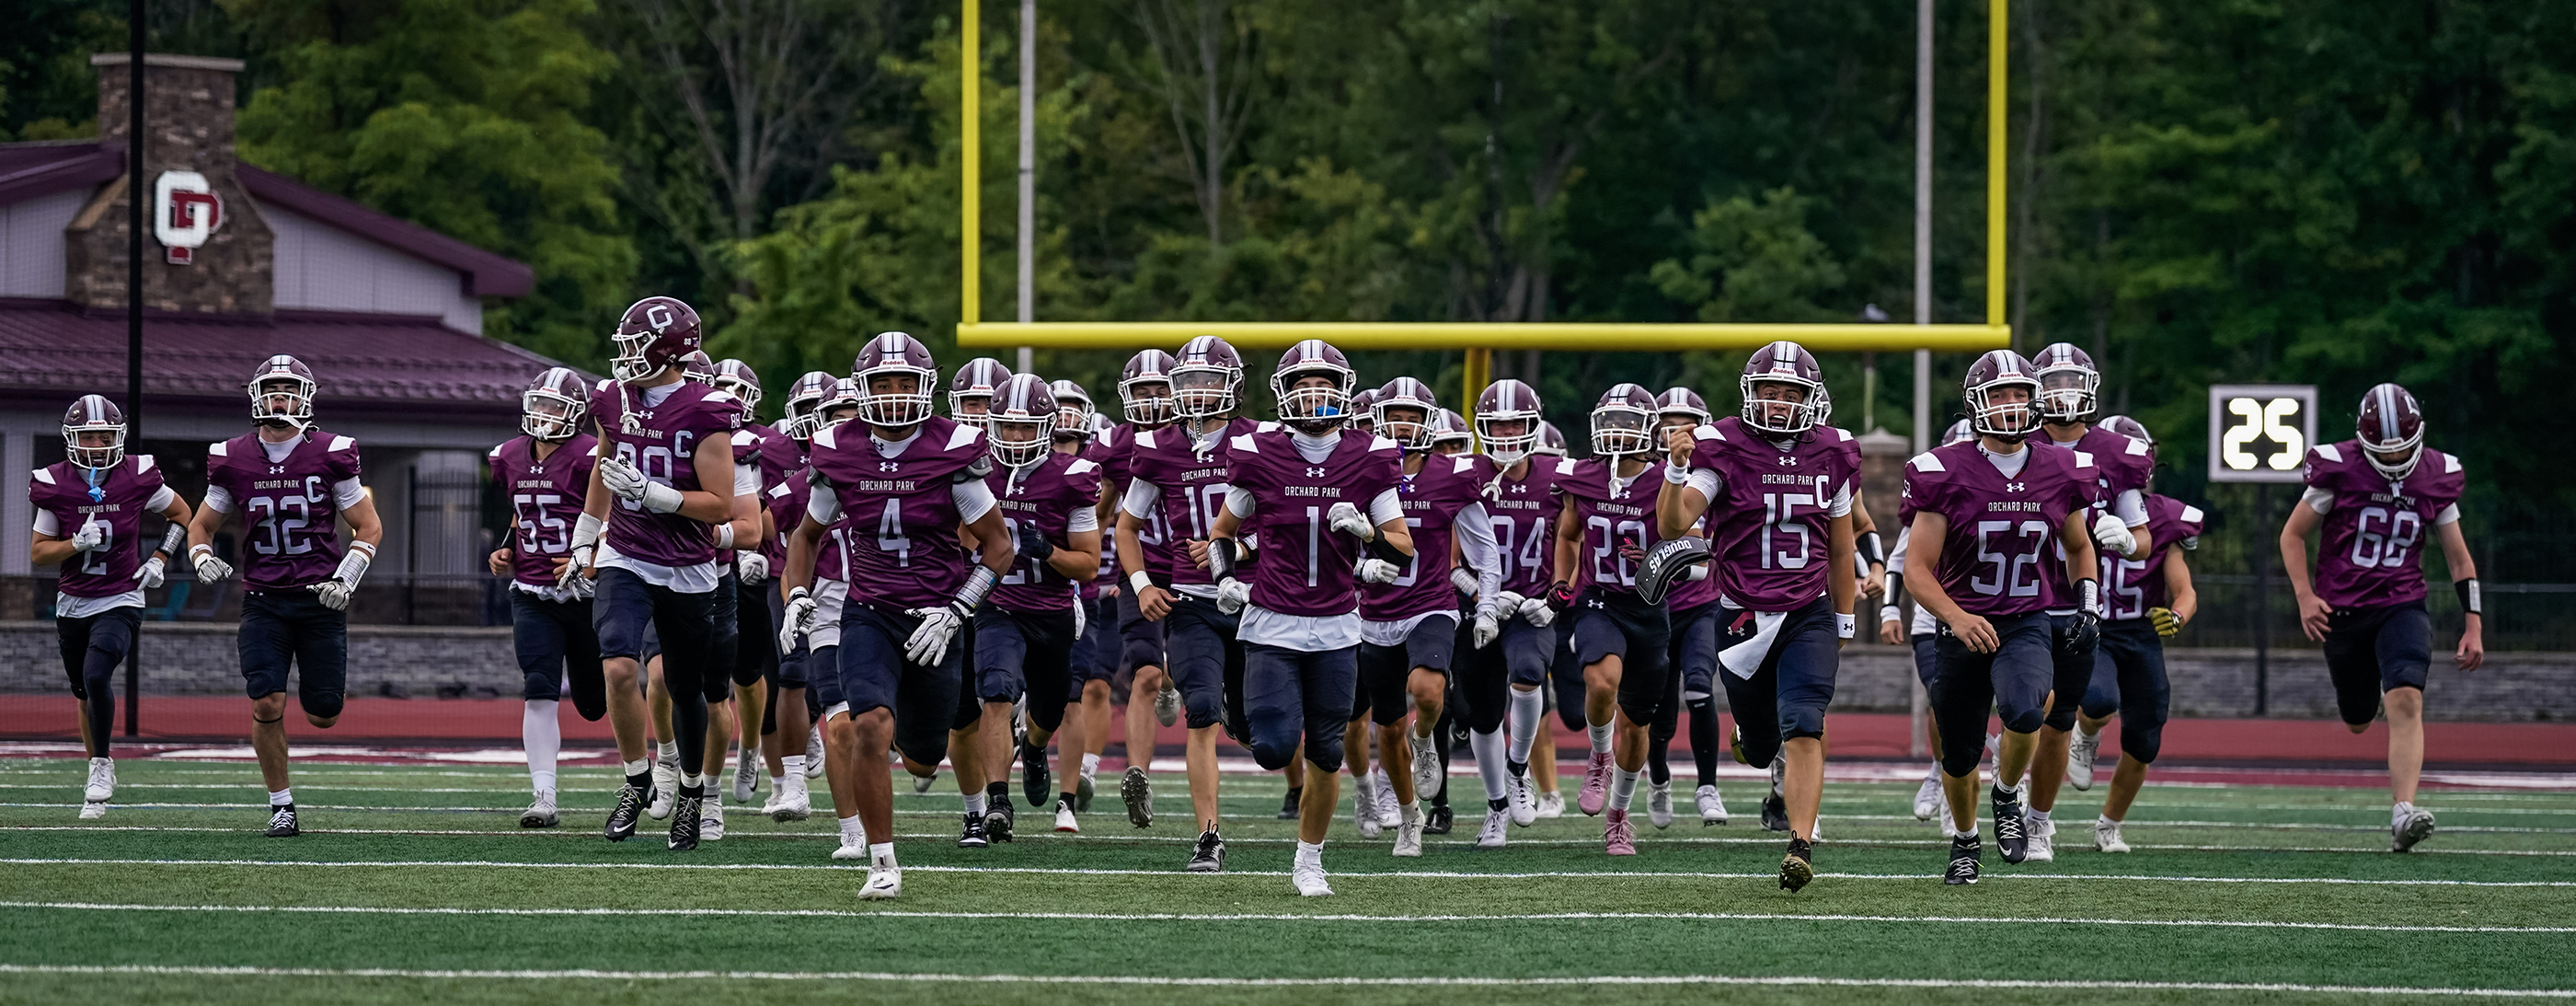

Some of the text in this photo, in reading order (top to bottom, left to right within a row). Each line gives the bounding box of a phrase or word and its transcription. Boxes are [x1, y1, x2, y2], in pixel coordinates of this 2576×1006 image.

[1773, 367, 1795, 376] Riddell
[730, 412, 741, 429] 88
[647, 429, 663, 440] PARK
[2223, 397, 2304, 470] 25
[674, 430, 693, 458] C
[1181, 468, 1211, 482] ORCHARD
[1762, 473, 1814, 486] ORCHARD PARK
[254, 480, 300, 490] ORCHARD PARK
[305, 475, 324, 503] C
[517, 480, 553, 490] ORCHARD PARK
[860, 480, 915, 491] ORCHARD PARK
[1284, 486, 1341, 498] ORCHARD PARK
[1815, 474, 1833, 510] C
[78, 503, 121, 515] ORCHARD PARK
[1019, 502, 1038, 513] PARK
[1414, 501, 1431, 510] PARK
[1495, 500, 1540, 510] ORCHARD PARK
[1596, 502, 1643, 516] ORCHARD PARK
[1987, 502, 2041, 513] ORCHARD PARK
[248, 495, 313, 555] 32
[513, 494, 569, 554] 55
[1761, 492, 1814, 570] 15
[878, 498, 912, 568] 4
[2351, 506, 2421, 569] 68
[82, 519, 113, 575] 2
[1306, 506, 1319, 587] 1
[1649, 539, 1693, 574] DOUGLAS
[1970, 520, 2049, 597] 52
